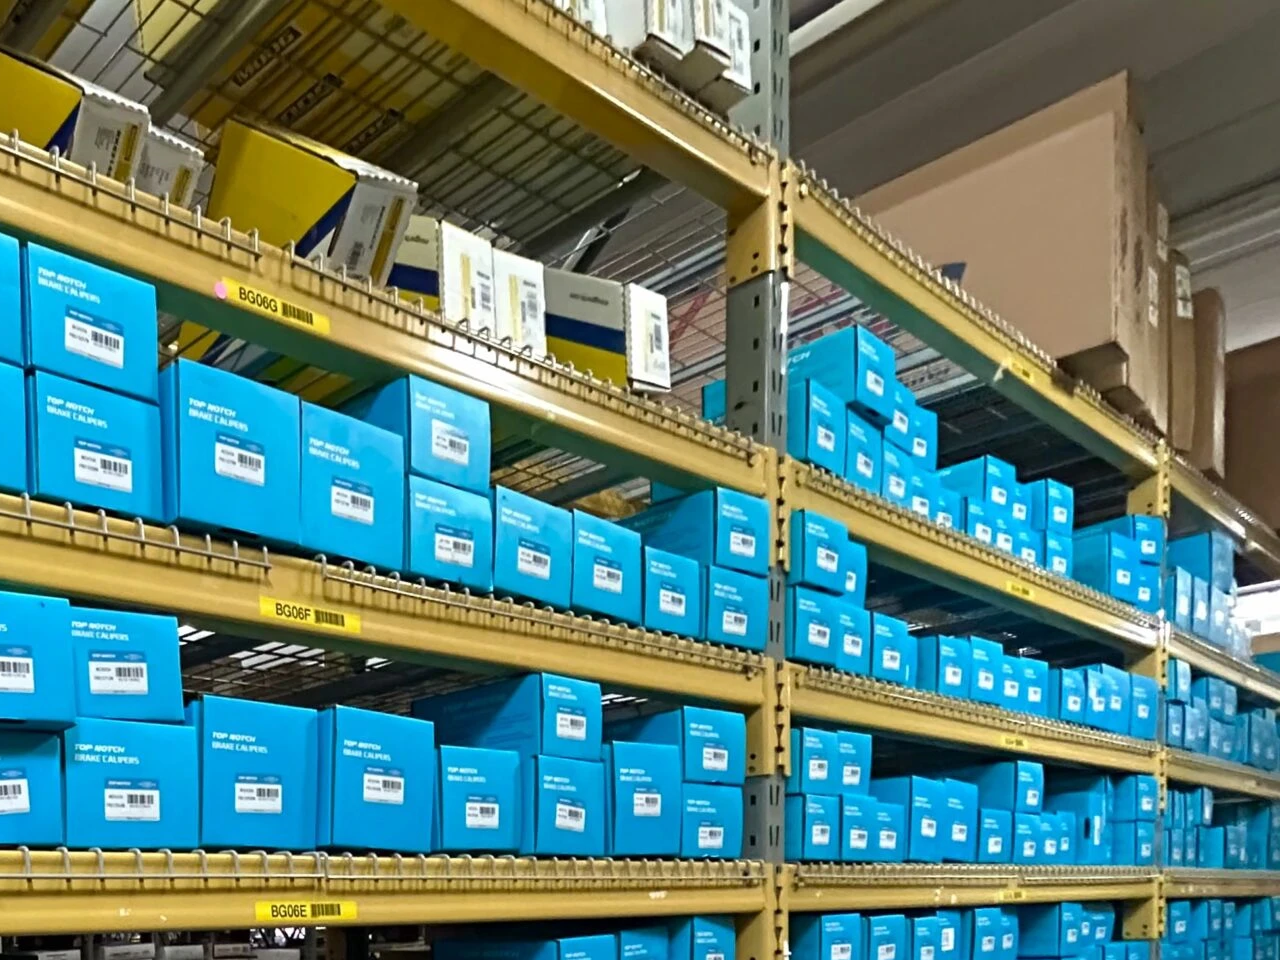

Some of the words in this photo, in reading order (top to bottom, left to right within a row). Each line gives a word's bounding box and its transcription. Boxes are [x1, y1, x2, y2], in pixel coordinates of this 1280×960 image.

[239, 287, 278, 313] BG06G
[275, 603, 311, 620] BG06F
[229, 734, 256, 742] NOTCH
[212, 742, 234, 750] BRAKE
[236, 744, 267, 753] CALIPERS
[75, 754, 100, 762] BRAKE
[102, 756, 139, 764] CALIPERS
[271, 904, 307, 918] BG06E
